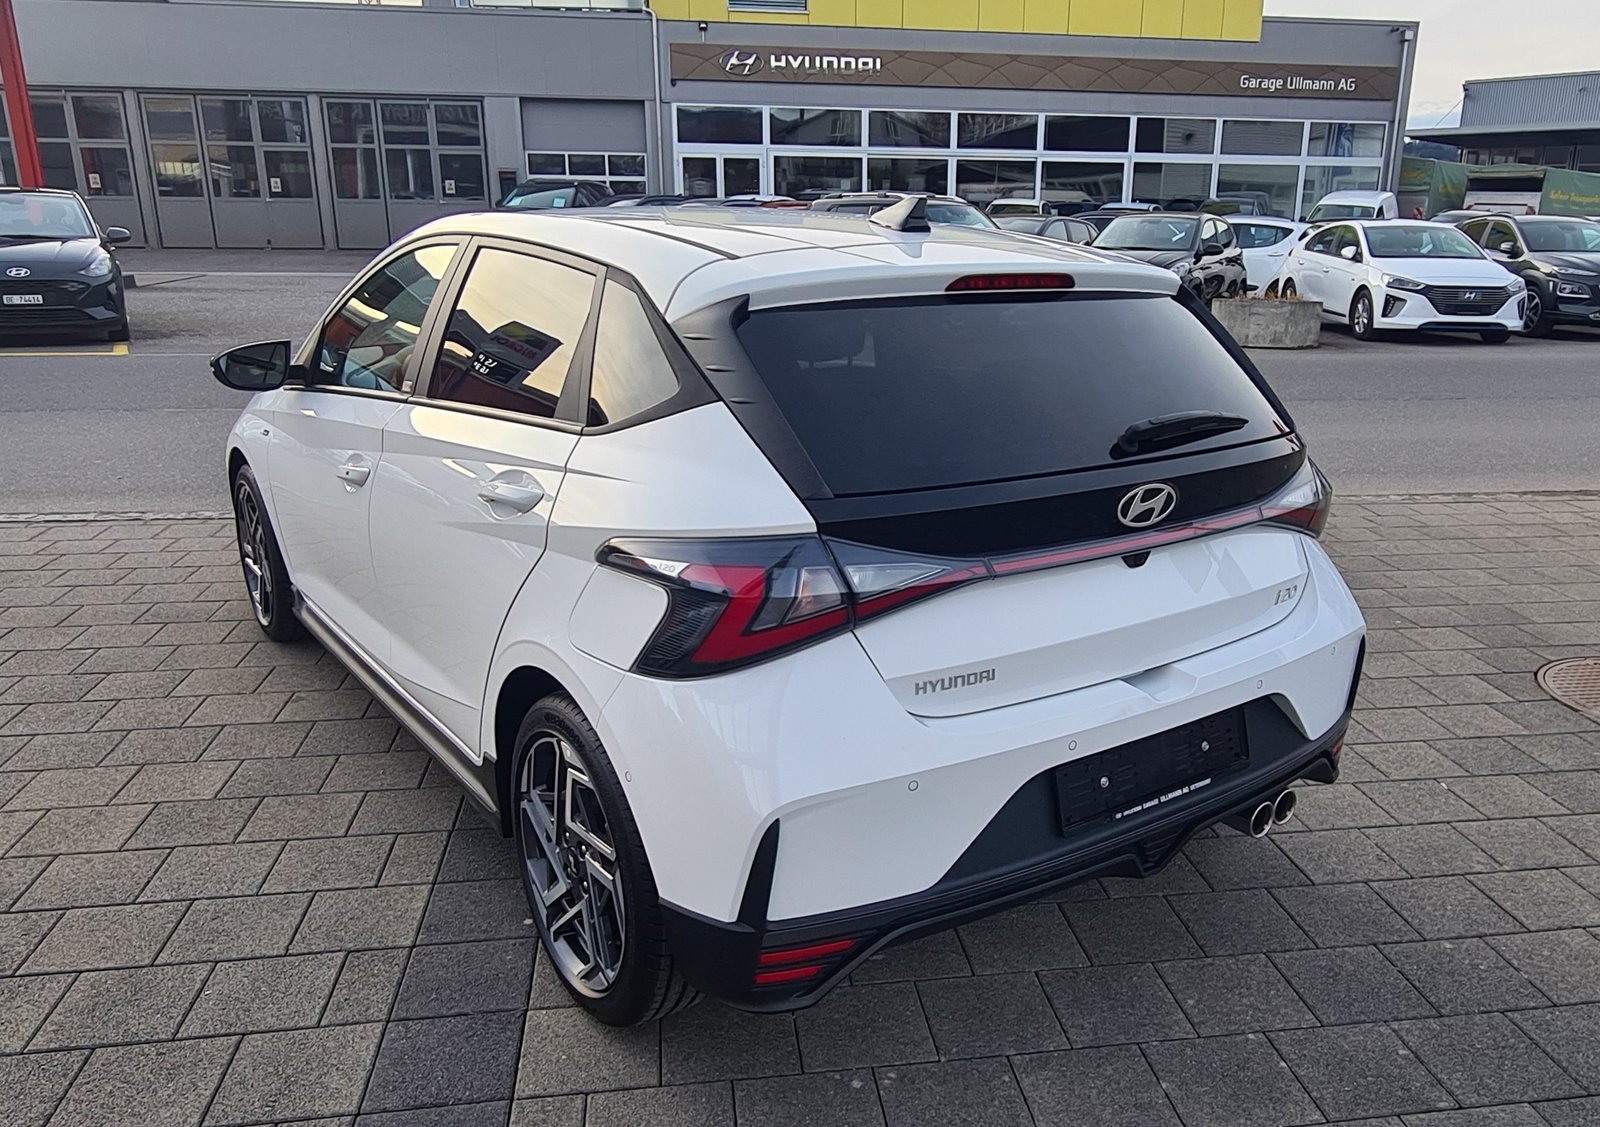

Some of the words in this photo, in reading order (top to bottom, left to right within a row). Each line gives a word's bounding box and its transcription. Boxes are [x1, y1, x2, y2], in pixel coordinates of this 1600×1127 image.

[770, 54, 881, 75] HYUNDAI
[1240, 75, 1283, 92] Garage
[1287, 76, 1335, 91] Ullmann
[1337, 78, 1357, 91] AG
[914, 668, 996, 696] HYUNDAI
